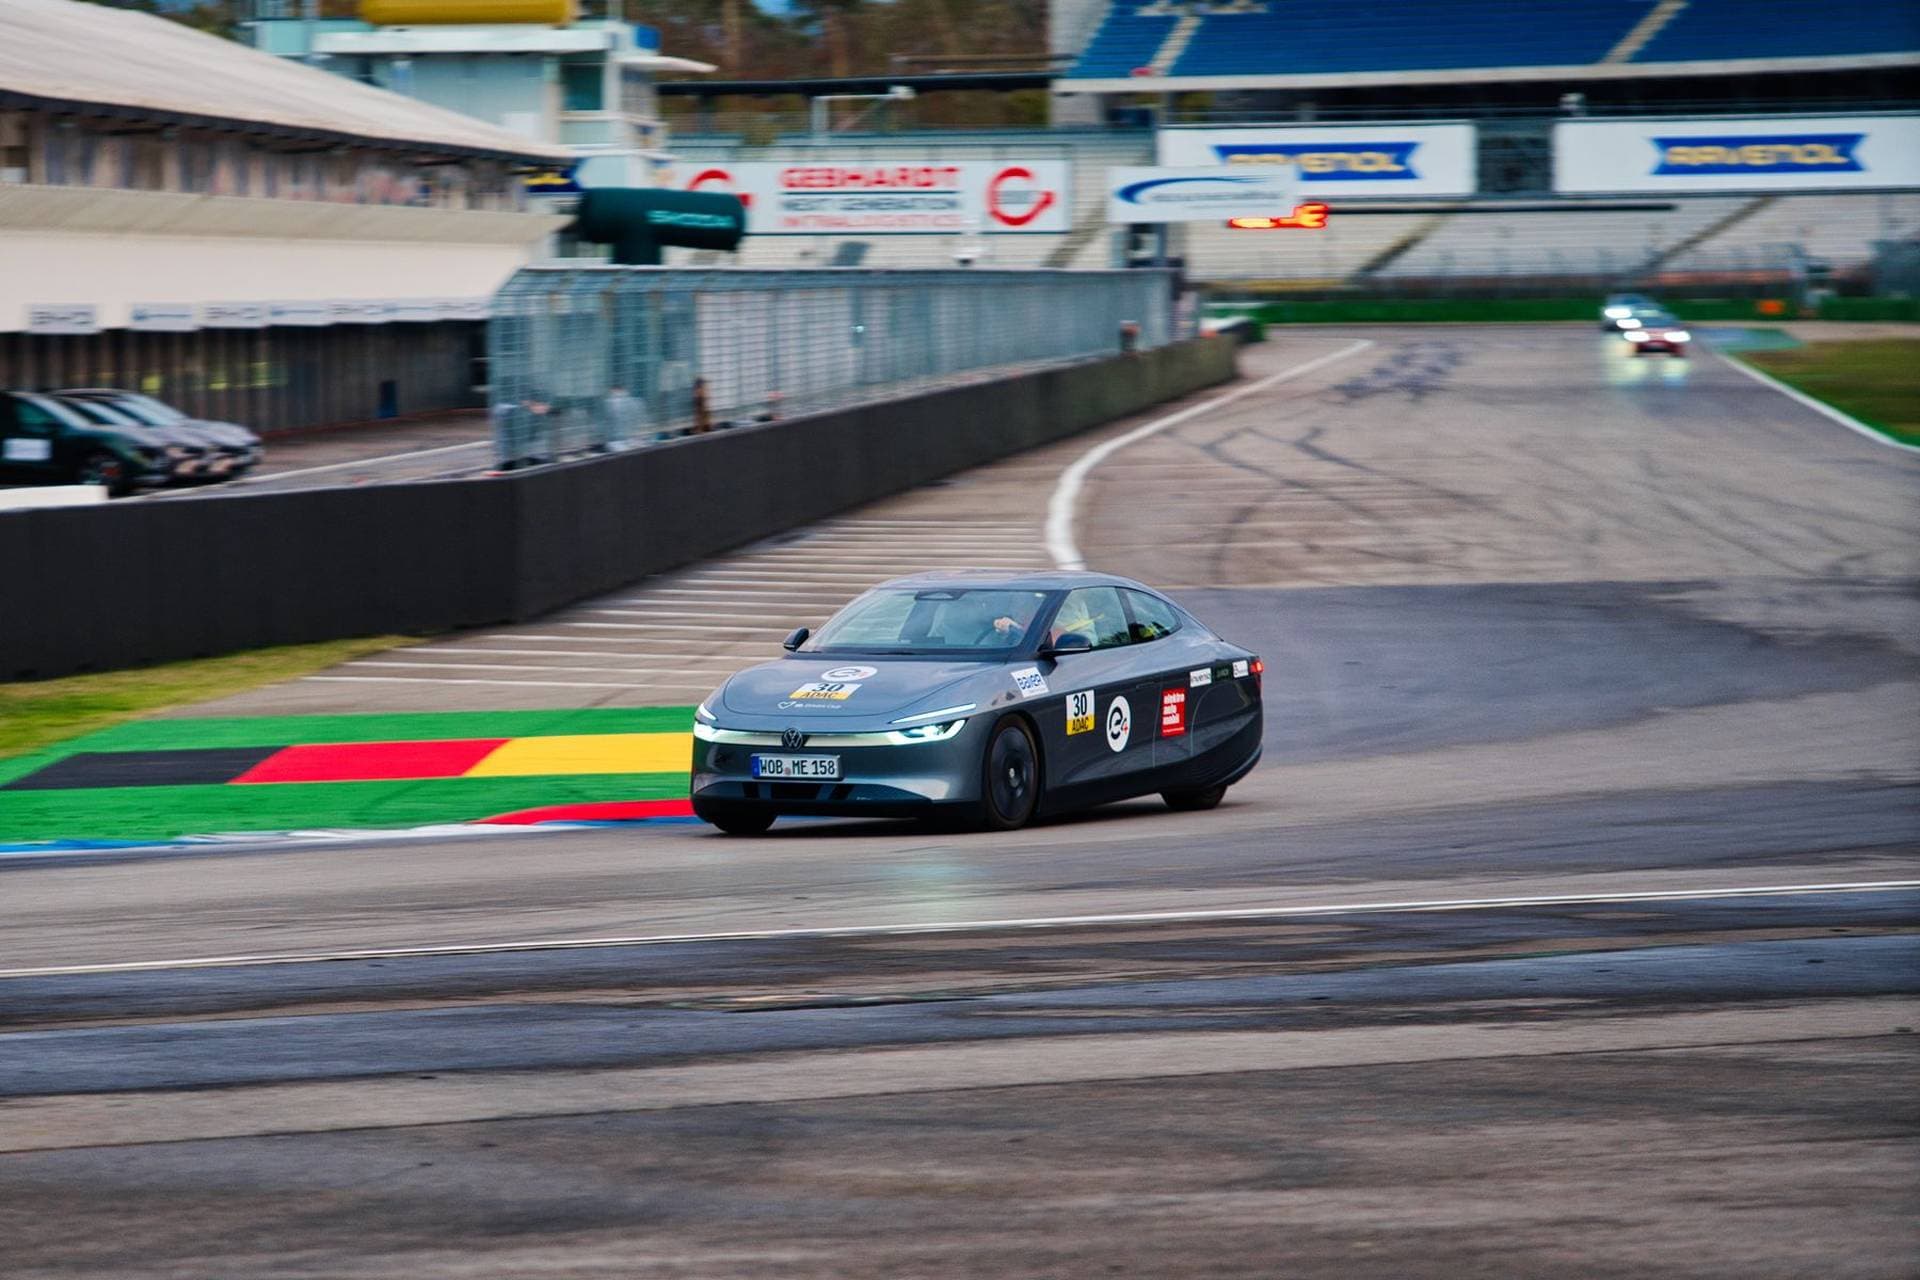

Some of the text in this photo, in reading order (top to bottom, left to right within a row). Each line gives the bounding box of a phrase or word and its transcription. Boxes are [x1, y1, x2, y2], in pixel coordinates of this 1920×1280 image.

[779, 167, 959, 188] GEBHARDT
[812, 683, 845, 692] 30
[1072, 693, 1088, 717] 30
[1072, 716, 1089, 732] ADAC
[760, 759, 835, 775] WOB ME 158
